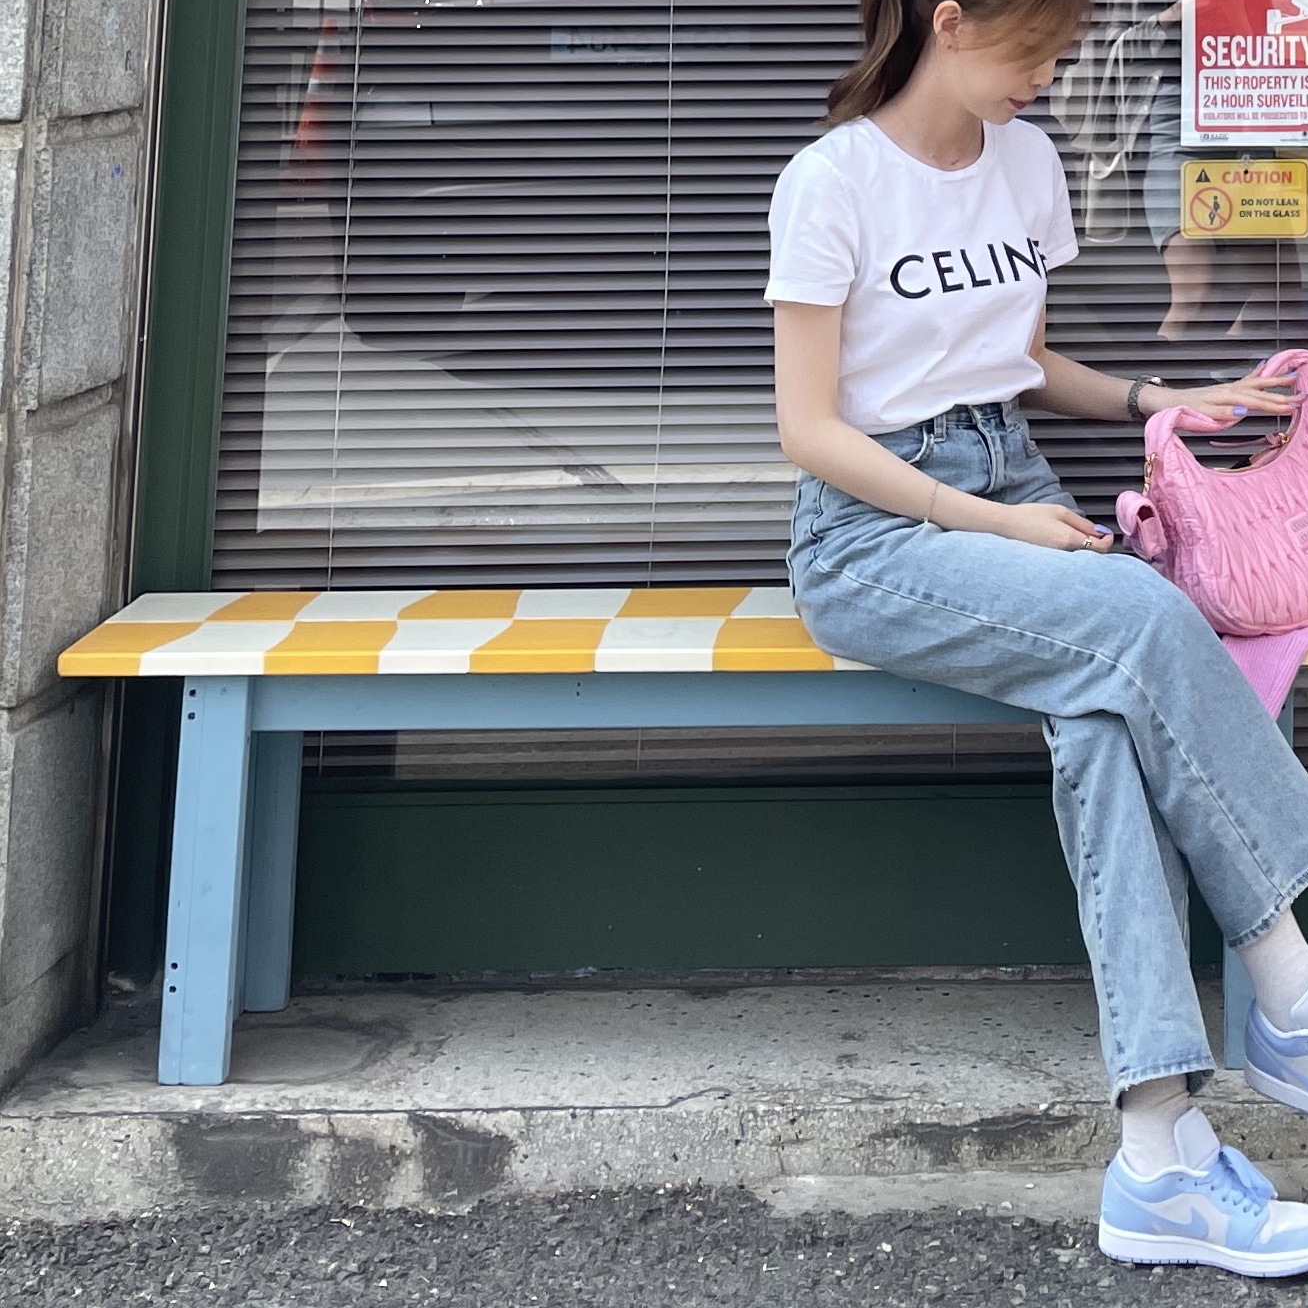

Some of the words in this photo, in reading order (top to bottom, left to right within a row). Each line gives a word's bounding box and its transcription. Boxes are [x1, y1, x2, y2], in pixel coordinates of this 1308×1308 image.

[1204, 76, 1231, 90] THIS
[1235, 76, 1297, 90] PROPERTY
[1203, 94, 1218, 109] 24
[1222, 94, 1253, 109] HOUR
[1222, 171, 1293, 184] CAUTION
[1241, 198, 1254, 206] DO
[1256, 198, 1274, 206] NOT
[1276, 198, 1299, 206] LEAN
[1240, 210, 1253, 218] ON
[1255, 210, 1271, 218] THE
[1273, 210, 1301, 218] GLASS
